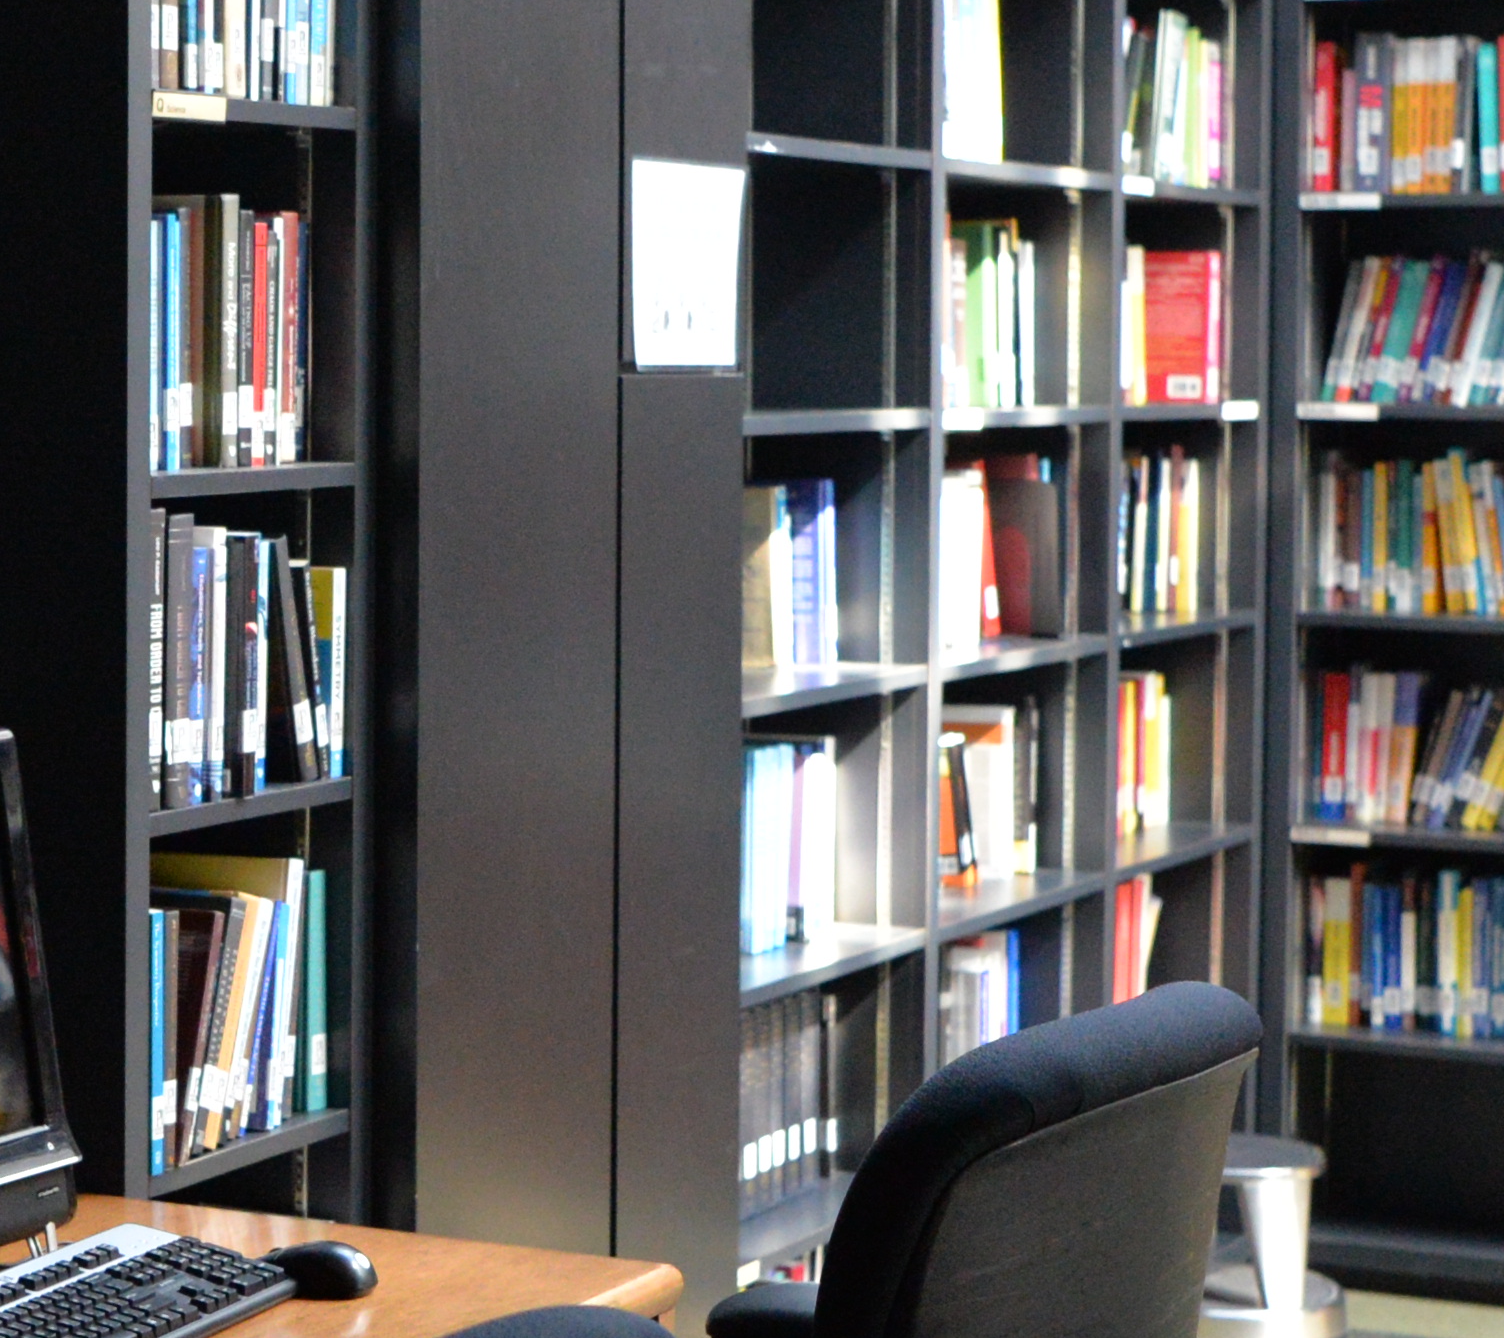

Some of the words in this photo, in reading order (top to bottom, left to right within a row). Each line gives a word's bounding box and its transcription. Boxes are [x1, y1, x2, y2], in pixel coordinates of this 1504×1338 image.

[156, 97, 165, 113] Q
[227, 242, 237, 278] More
[227, 280, 235, 300] and
[268, 280, 276, 313] CHAOS
[222, 302, 238, 371] Different
[267, 314, 275, 335] AND
[149, 603, 163, 639] FROM
[148, 641, 163, 684] ORDER
[334, 614, 342, 701] SYMMETRY
[148, 687, 163, 704] TO
